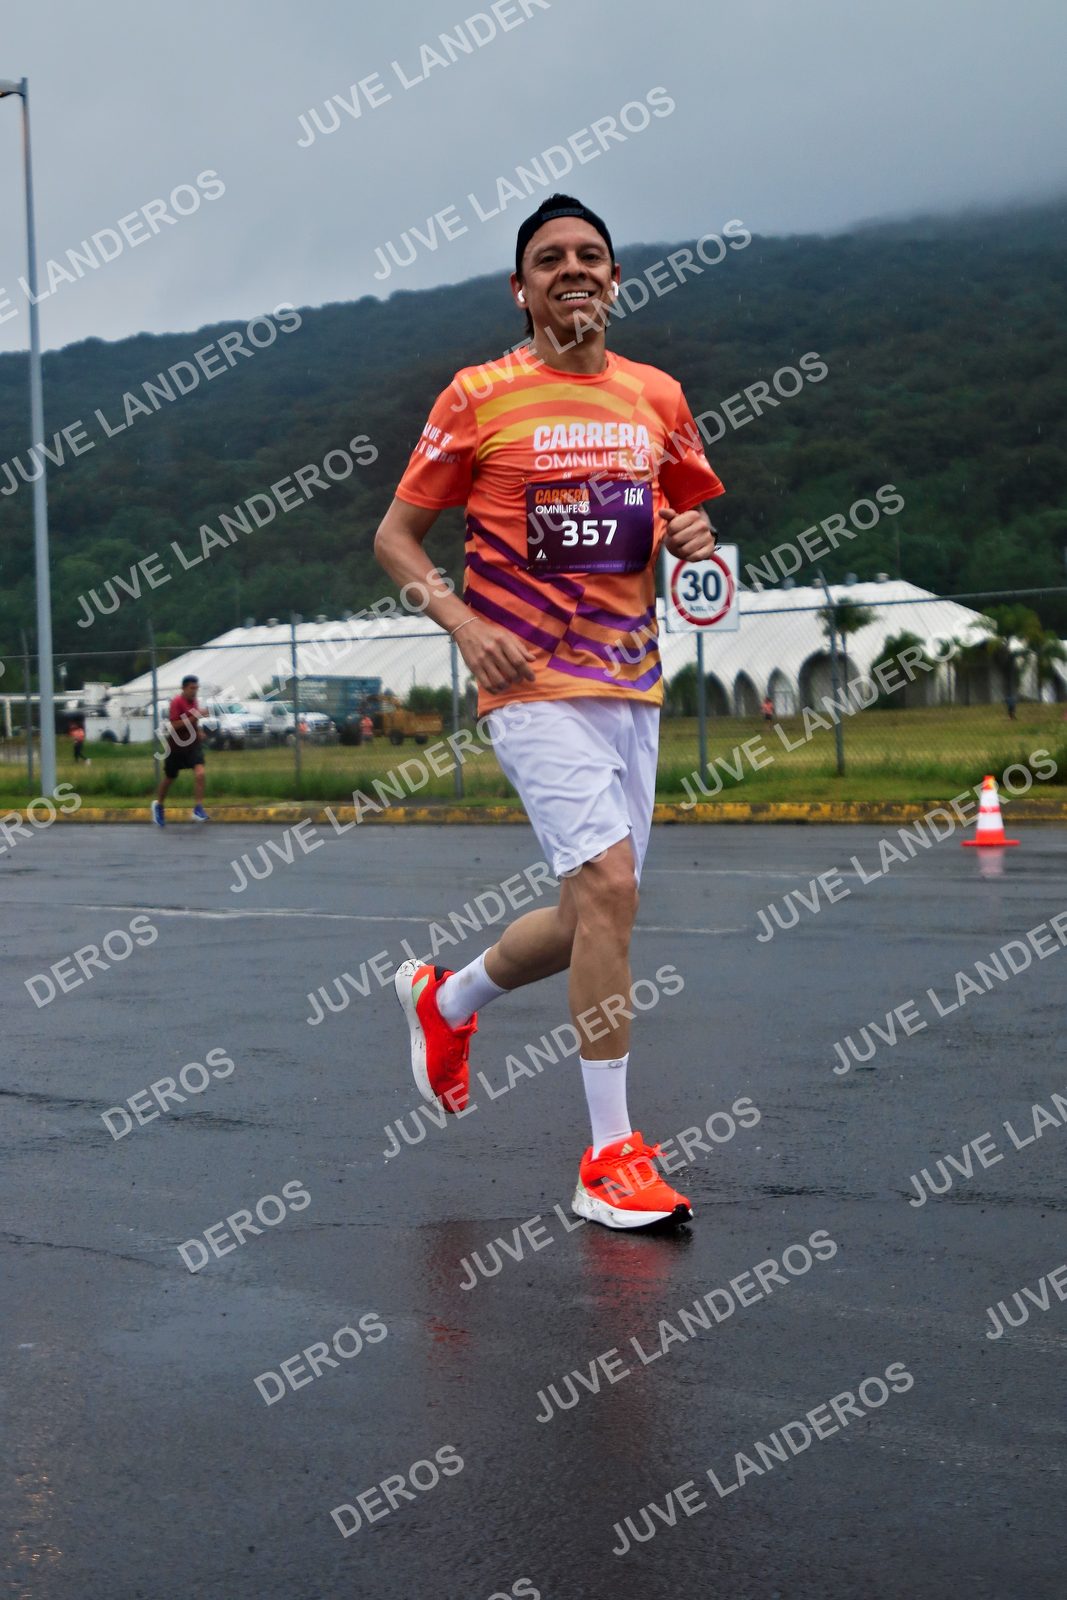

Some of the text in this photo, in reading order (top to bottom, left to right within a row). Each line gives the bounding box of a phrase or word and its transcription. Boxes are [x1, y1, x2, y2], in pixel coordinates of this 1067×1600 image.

[533, 422, 650, 451] CARRERA
[535, 488, 589, 504] CARRERA
[562, 519, 618, 546] 357
[681, 569, 722, 602] 30
